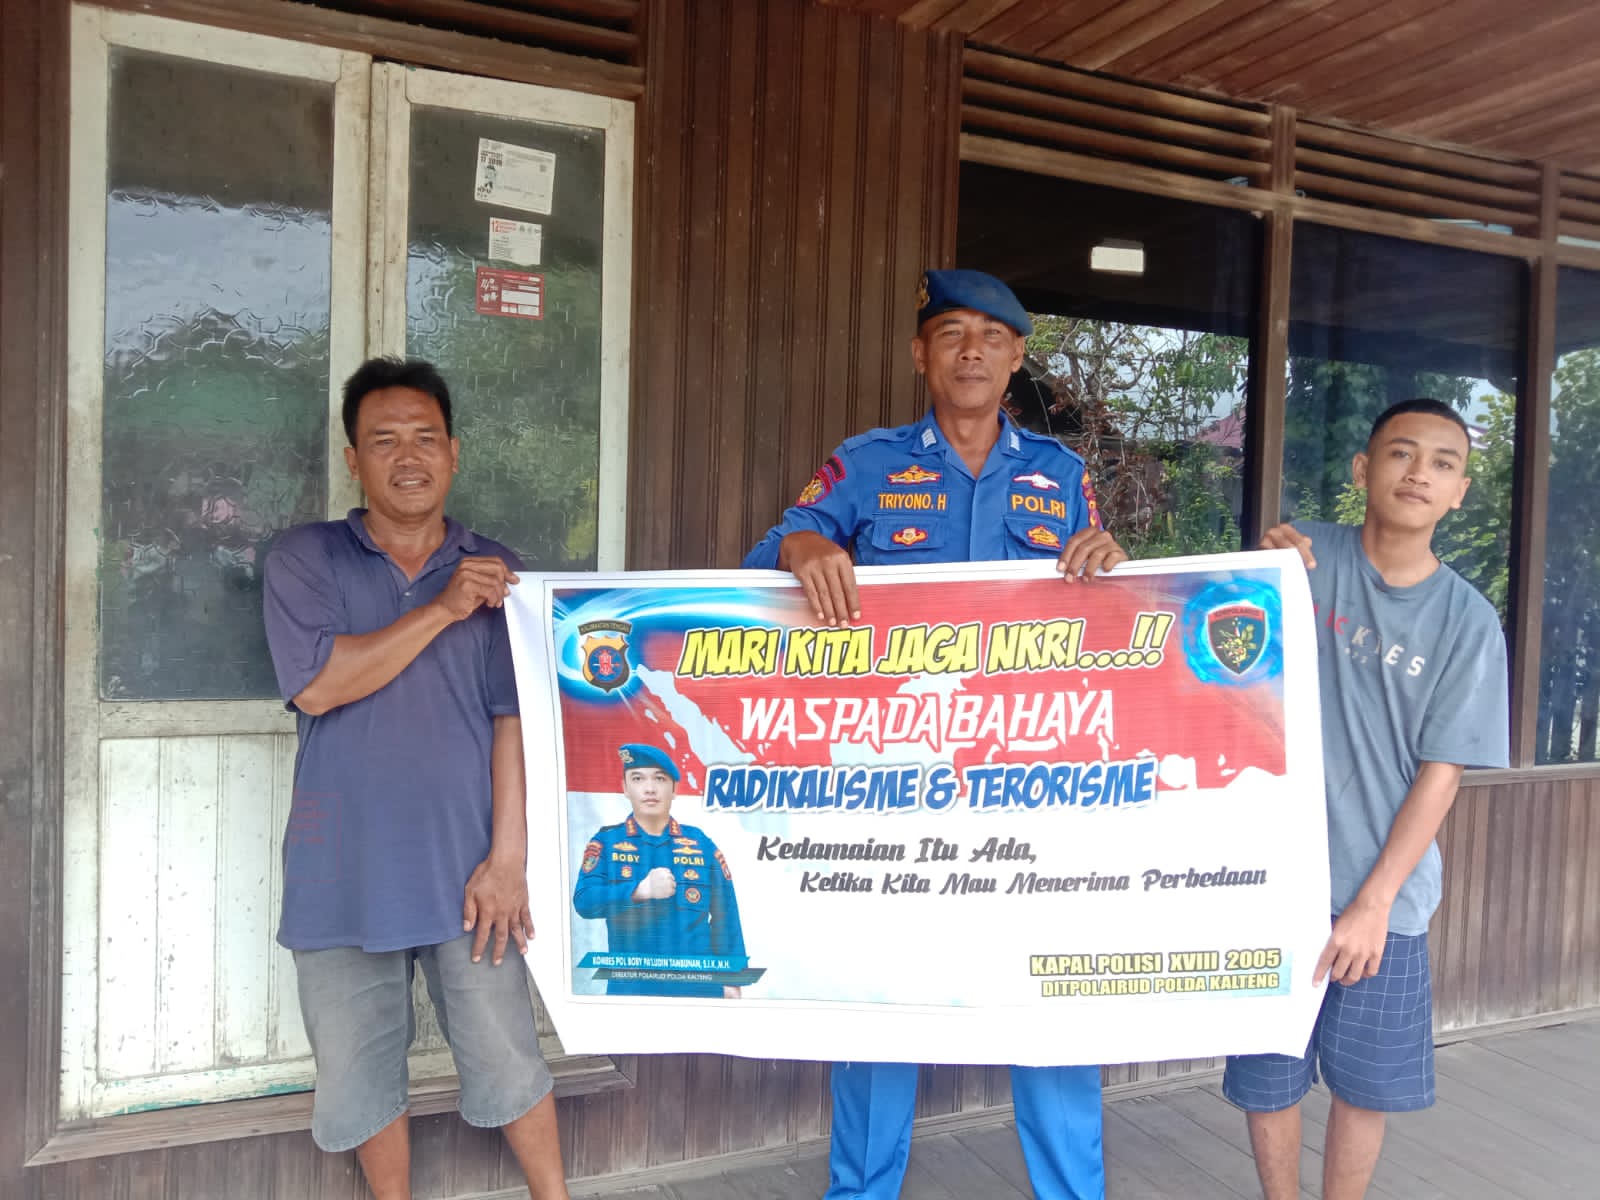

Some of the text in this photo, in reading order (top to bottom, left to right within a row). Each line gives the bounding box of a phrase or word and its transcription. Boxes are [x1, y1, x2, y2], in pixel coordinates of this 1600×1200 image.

[937, 494, 946, 511] H
[1011, 494, 1066, 519] POLRI
[678, 627, 779, 677] MARI
[784, 626, 871, 676] KITA
[876, 623, 979, 675] JAGA
[740, 691, 1114, 752] WASPADA BAHAYA
[706, 758, 1156, 810] RADIKALISME & TERORISME
[611, 853, 640, 863] BOBY
[674, 856, 704, 866] POLRI
[757, 836, 1036, 864] Kedamaian Itu Ada,
[800, 866, 1266, 895] Ketika Kita Mau Menerima Perbedaan
[1030, 948, 1281, 976] KAPAL POLISI XVIII 2005
[1042, 973, 1279, 997] DITPOLAIRUD POLDA KALTENG
